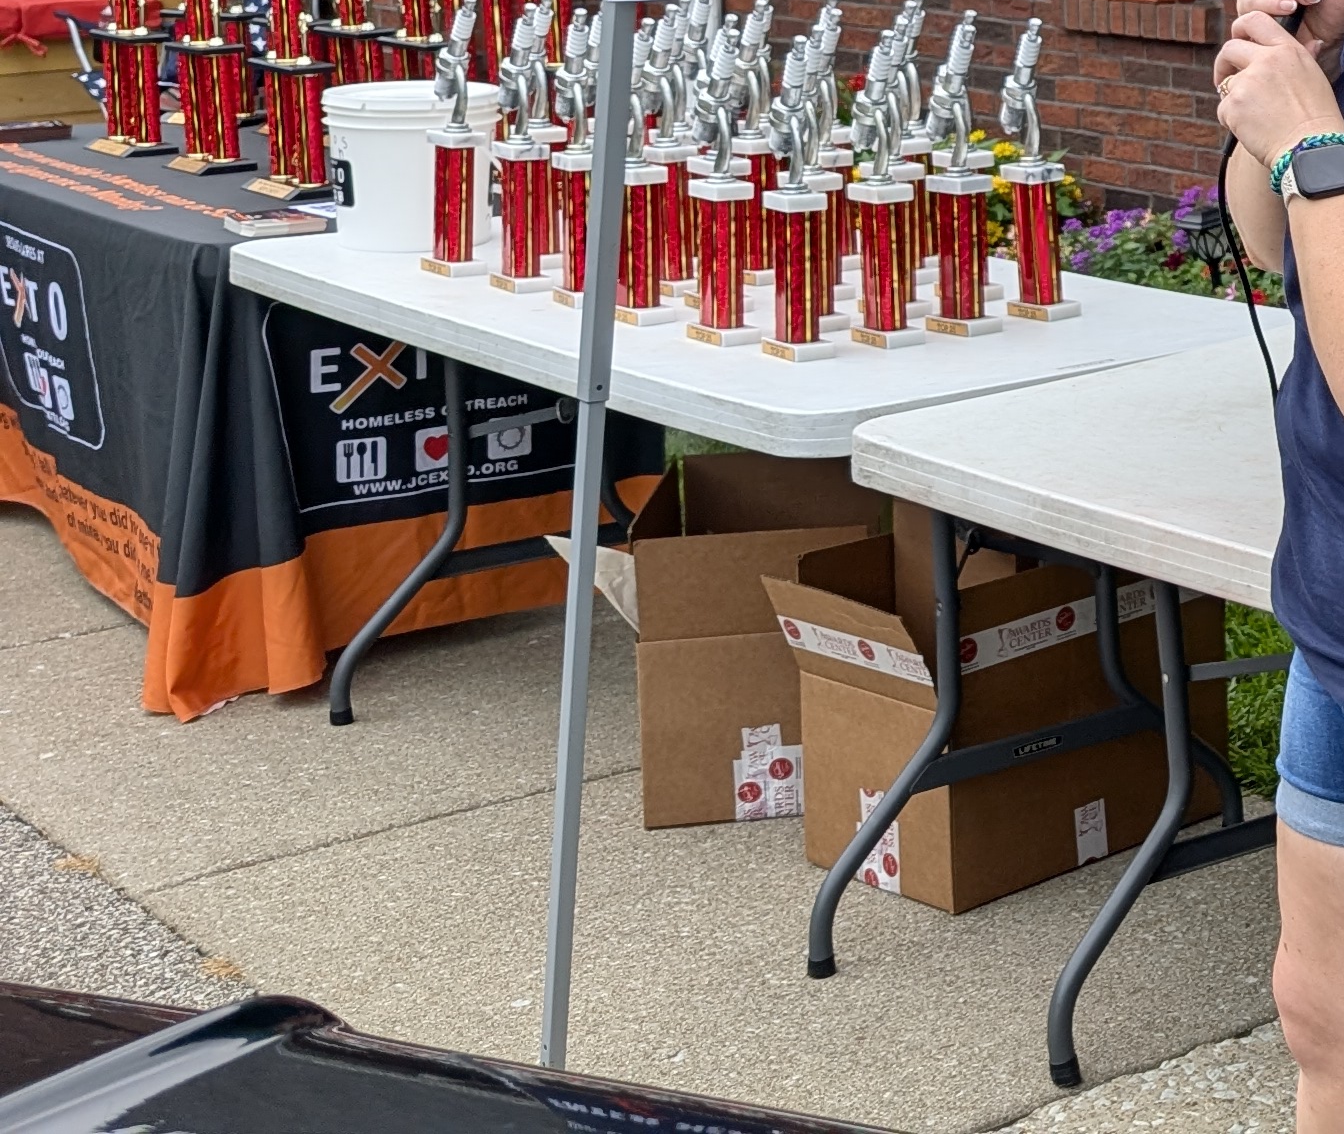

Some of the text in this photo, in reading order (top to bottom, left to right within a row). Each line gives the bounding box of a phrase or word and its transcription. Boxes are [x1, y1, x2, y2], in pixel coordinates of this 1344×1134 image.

[341, 406, 435, 430] HOMELESS
[1007, 617, 1051, 639] AWARDS
[1009, 630, 1053, 650] CENTER
